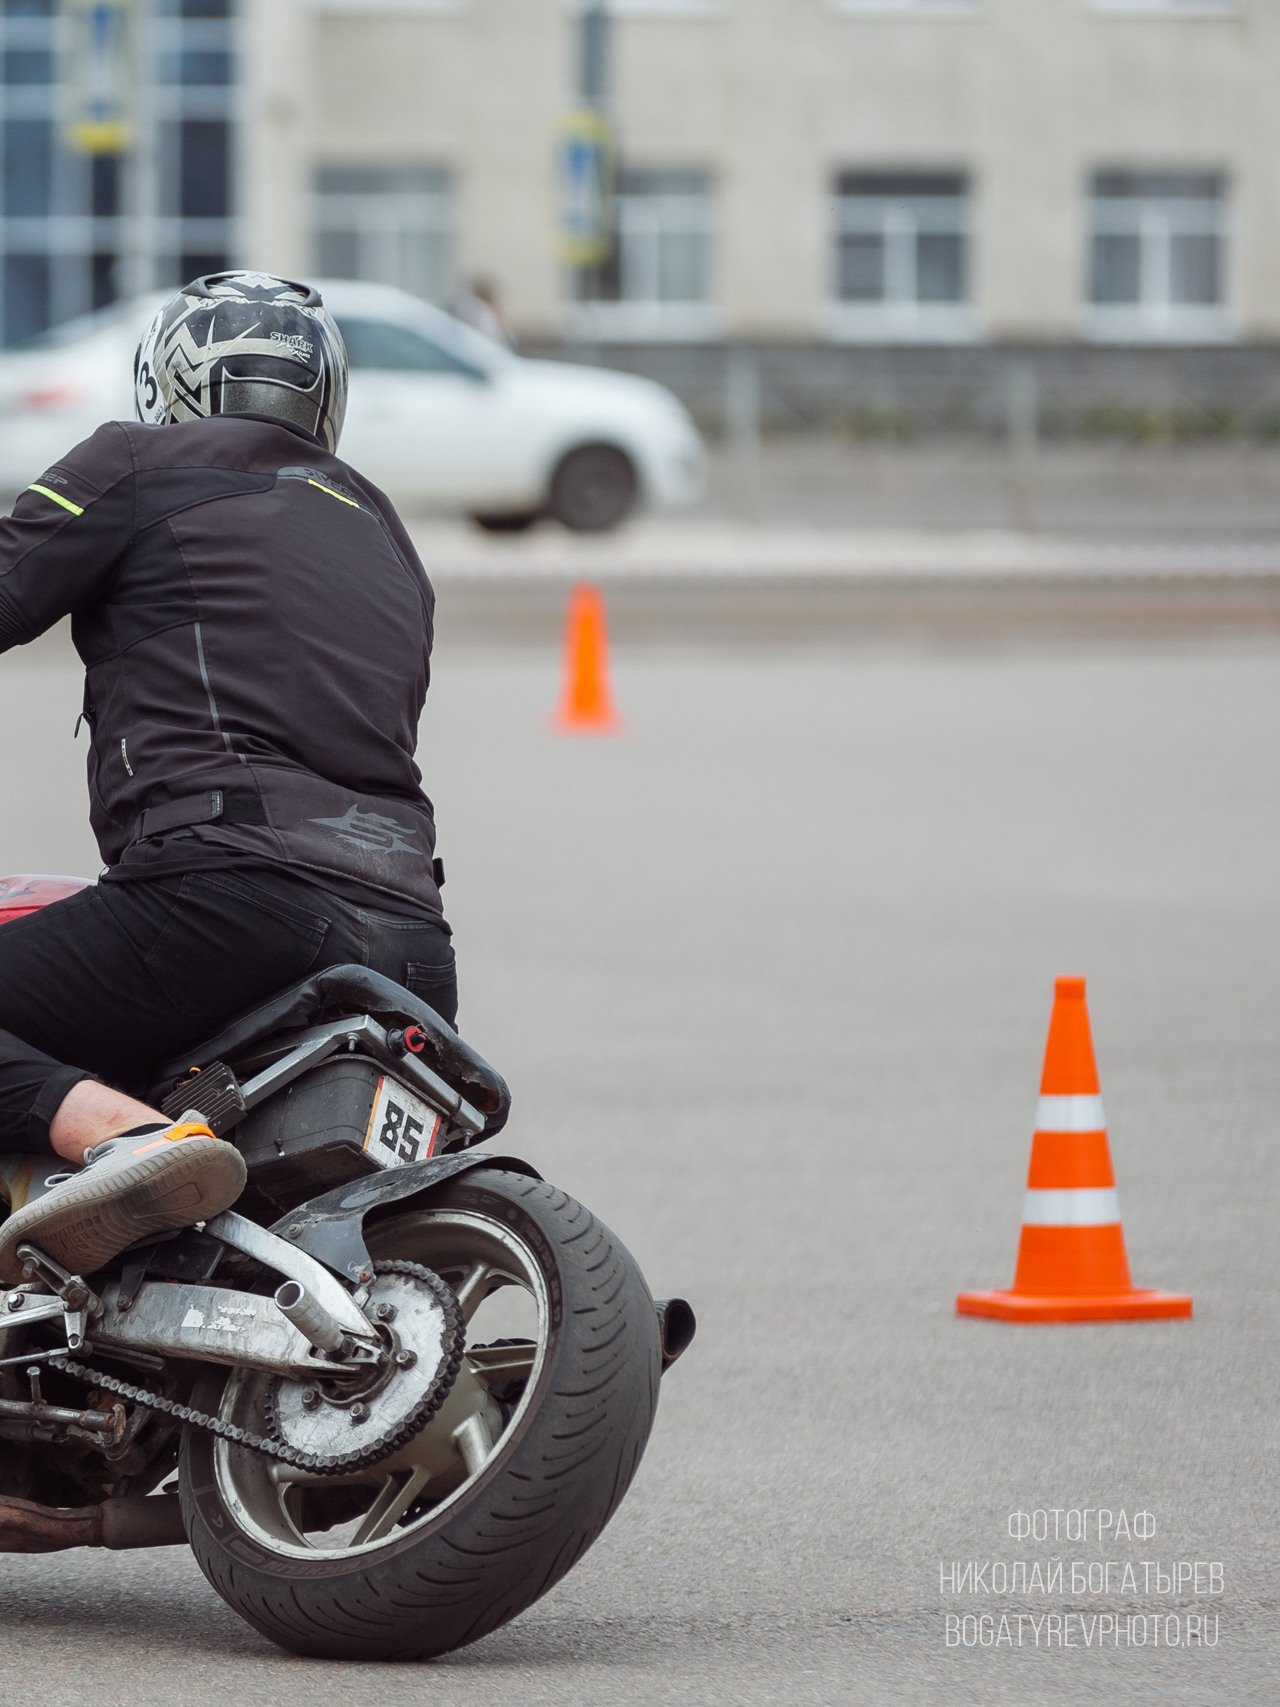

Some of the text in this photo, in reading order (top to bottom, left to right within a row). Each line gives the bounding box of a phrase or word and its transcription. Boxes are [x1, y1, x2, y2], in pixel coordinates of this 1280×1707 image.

[270, 332, 314, 354] SHARK
[40, 472, 68, 486] EEP
[379, 1099, 425, 1162] 85
